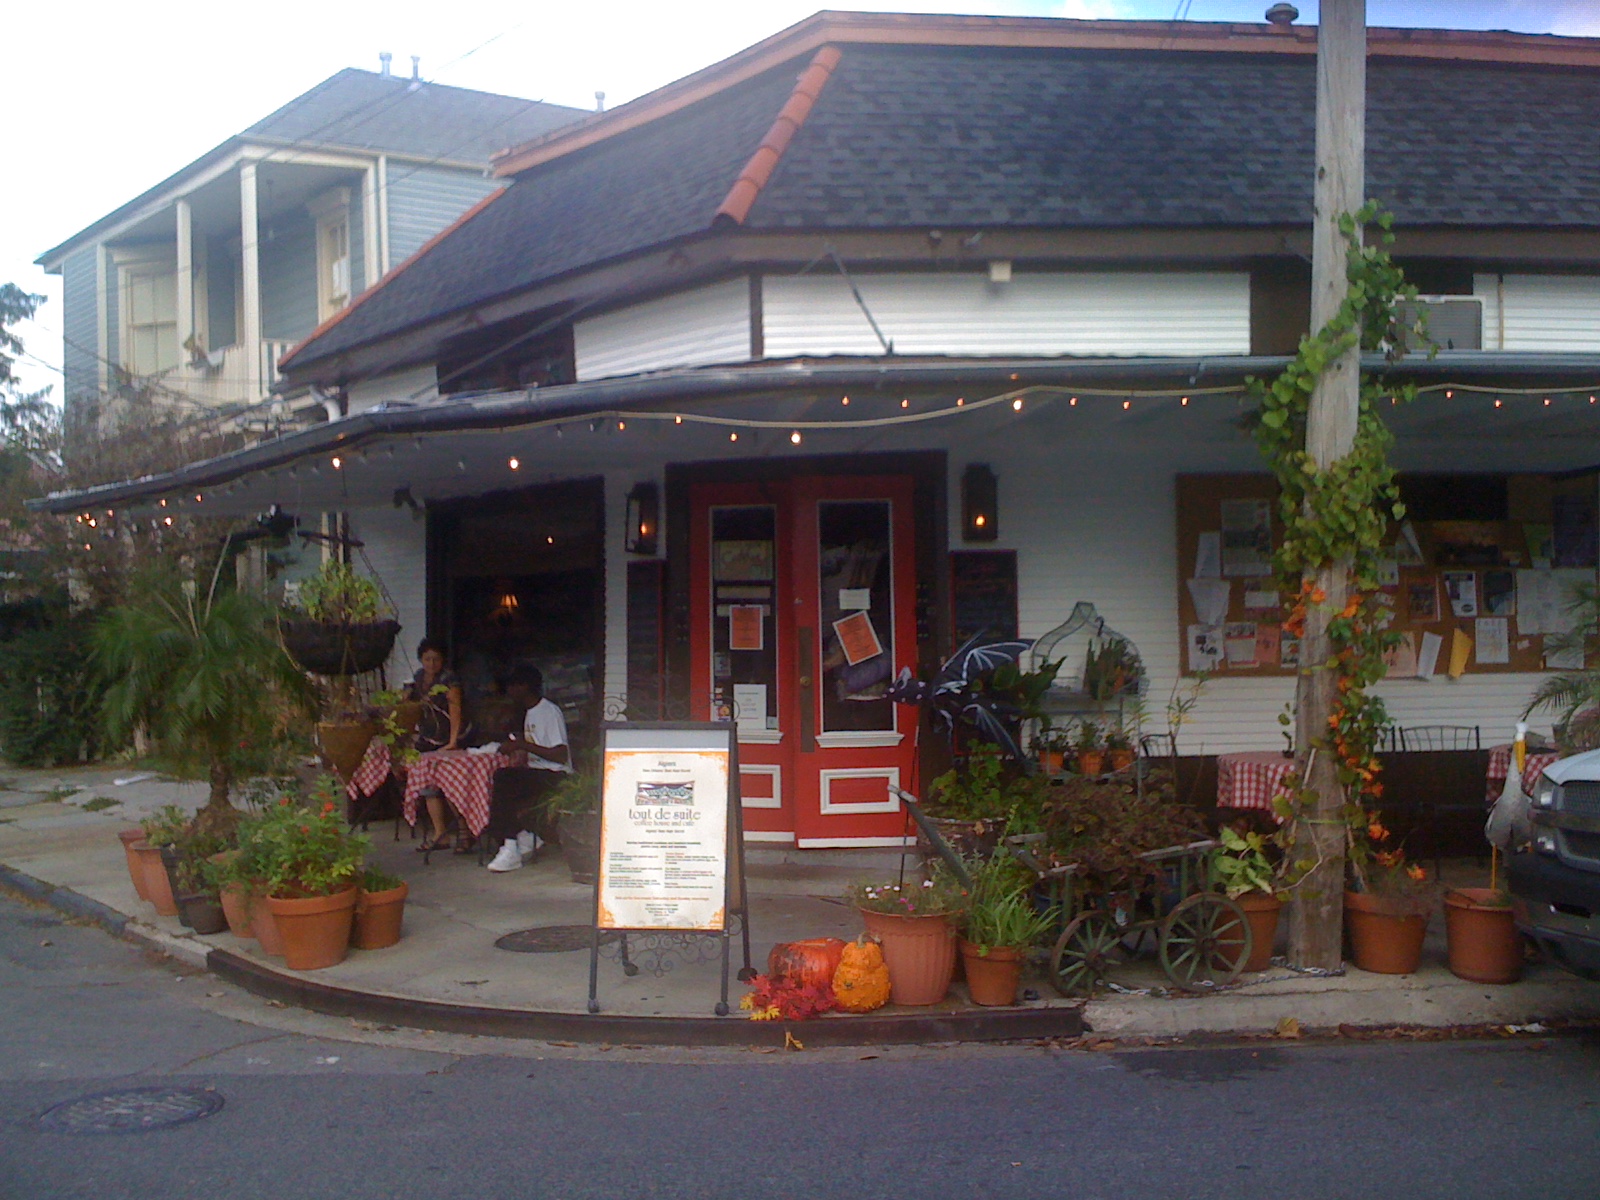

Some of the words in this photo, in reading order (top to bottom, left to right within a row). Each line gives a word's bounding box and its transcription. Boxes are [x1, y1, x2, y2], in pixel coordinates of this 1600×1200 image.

[629, 808, 652, 820] tout
[655, 808, 671, 820] de
[673, 808, 701, 820] suite
